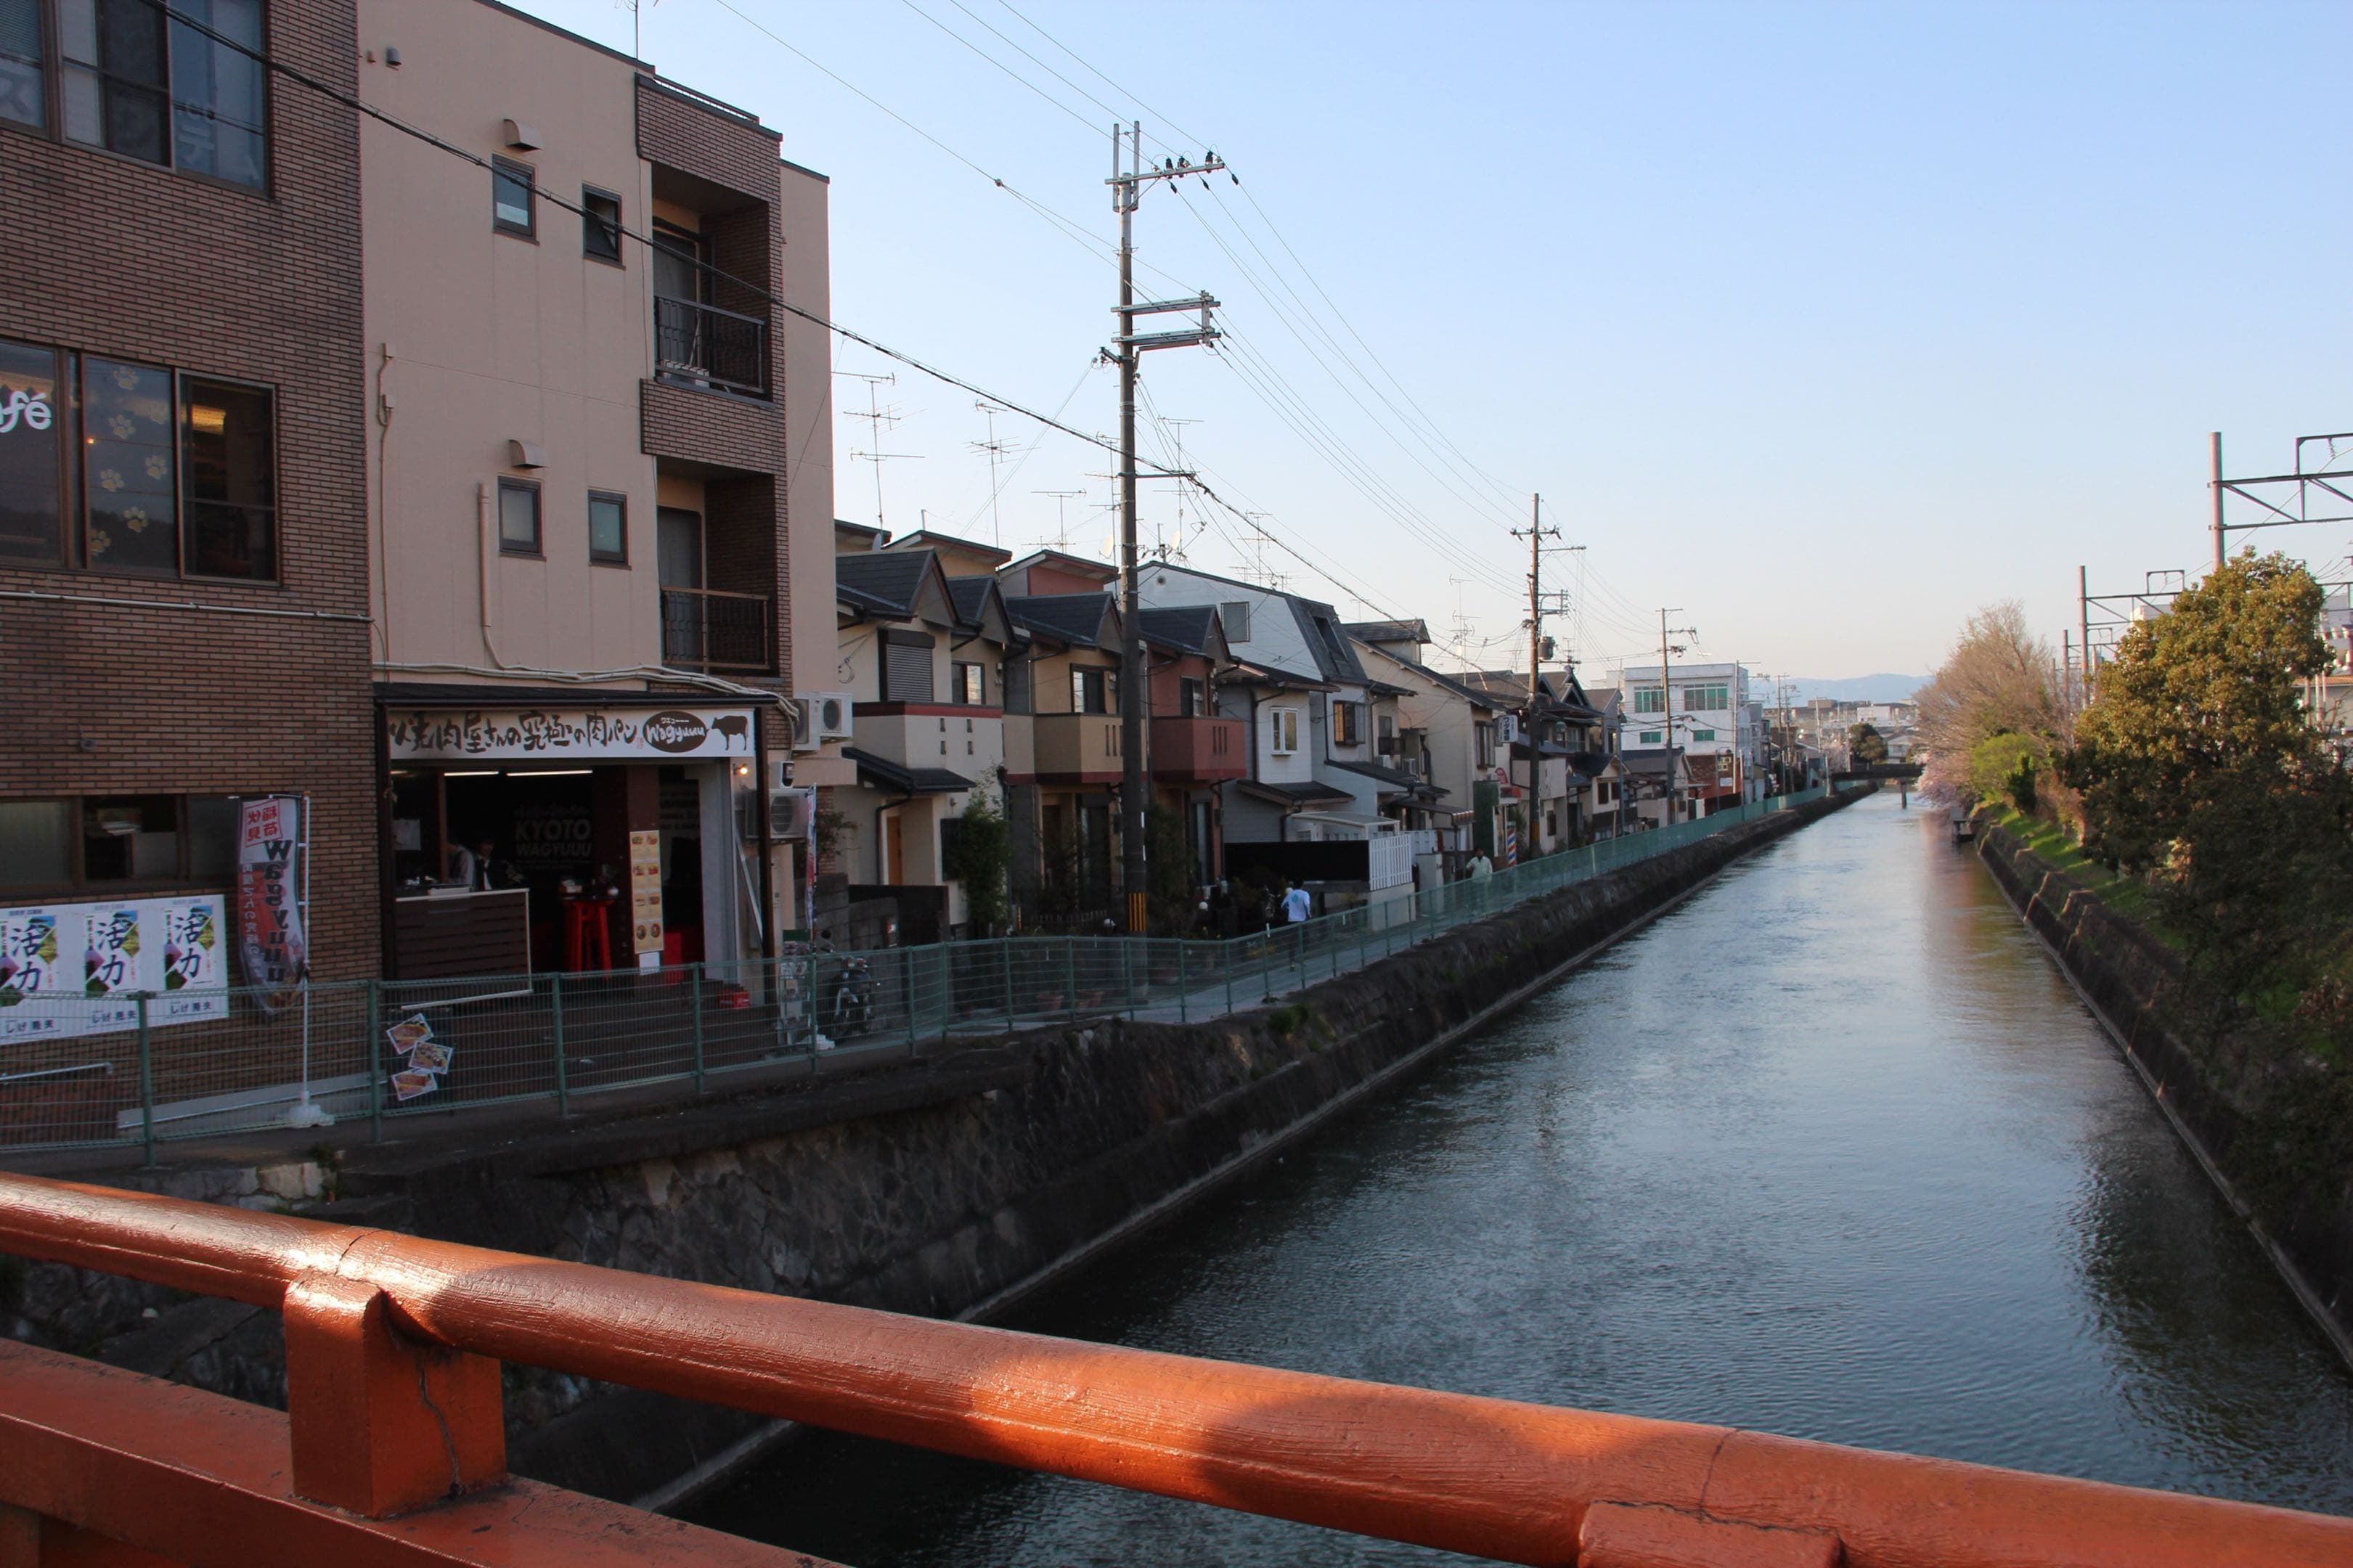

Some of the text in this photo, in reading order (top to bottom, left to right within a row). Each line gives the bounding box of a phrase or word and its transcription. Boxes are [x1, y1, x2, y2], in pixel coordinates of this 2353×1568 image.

[0, 391, 52, 433] fé
[389, 710, 637, 754] 焼肉屋さんの究極の肉パン
[646, 723, 704, 743] Wagyuuu
[516, 818, 591, 840] KYOTO
[516, 843, 592, 857] WAGYUUU
[11, 924, 48, 991] 活力
[97, 918, 130, 985] 活力
[176, 912, 208, 978] 活力
